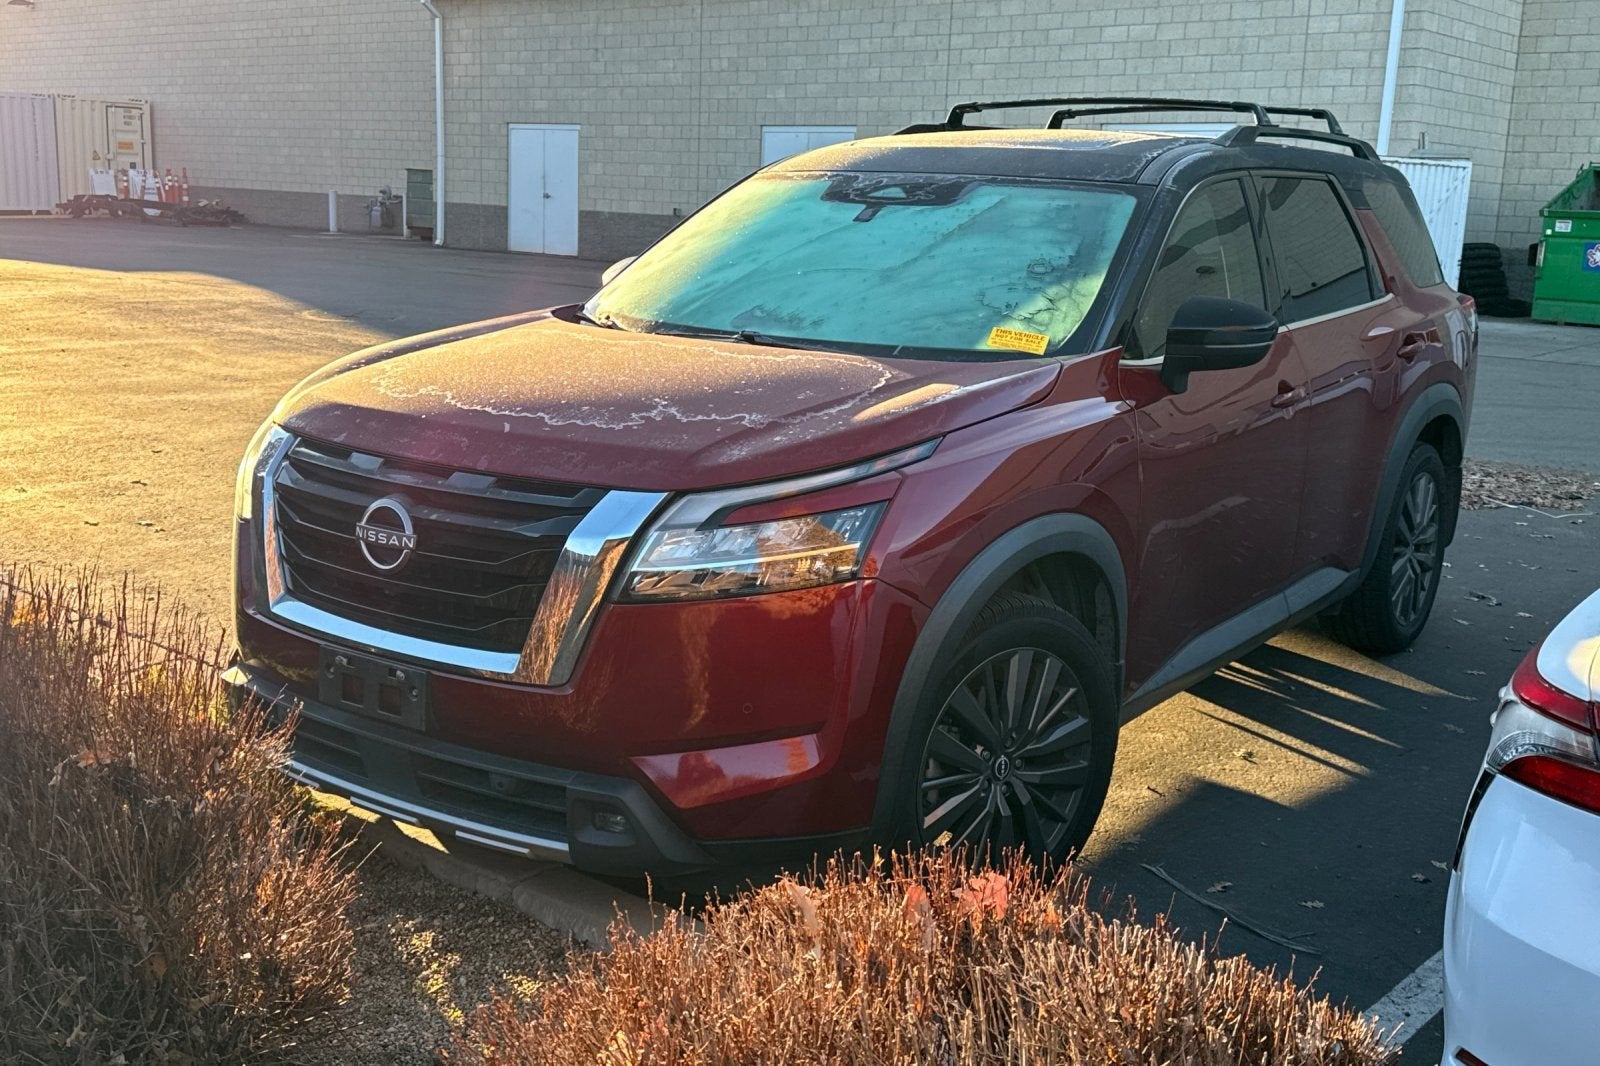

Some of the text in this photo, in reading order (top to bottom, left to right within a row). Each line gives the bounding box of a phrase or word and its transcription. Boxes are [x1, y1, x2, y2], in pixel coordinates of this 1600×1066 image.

[996, 328, 1045, 342] THIS VEHICLE
[355, 525, 414, 548] NISSAN
